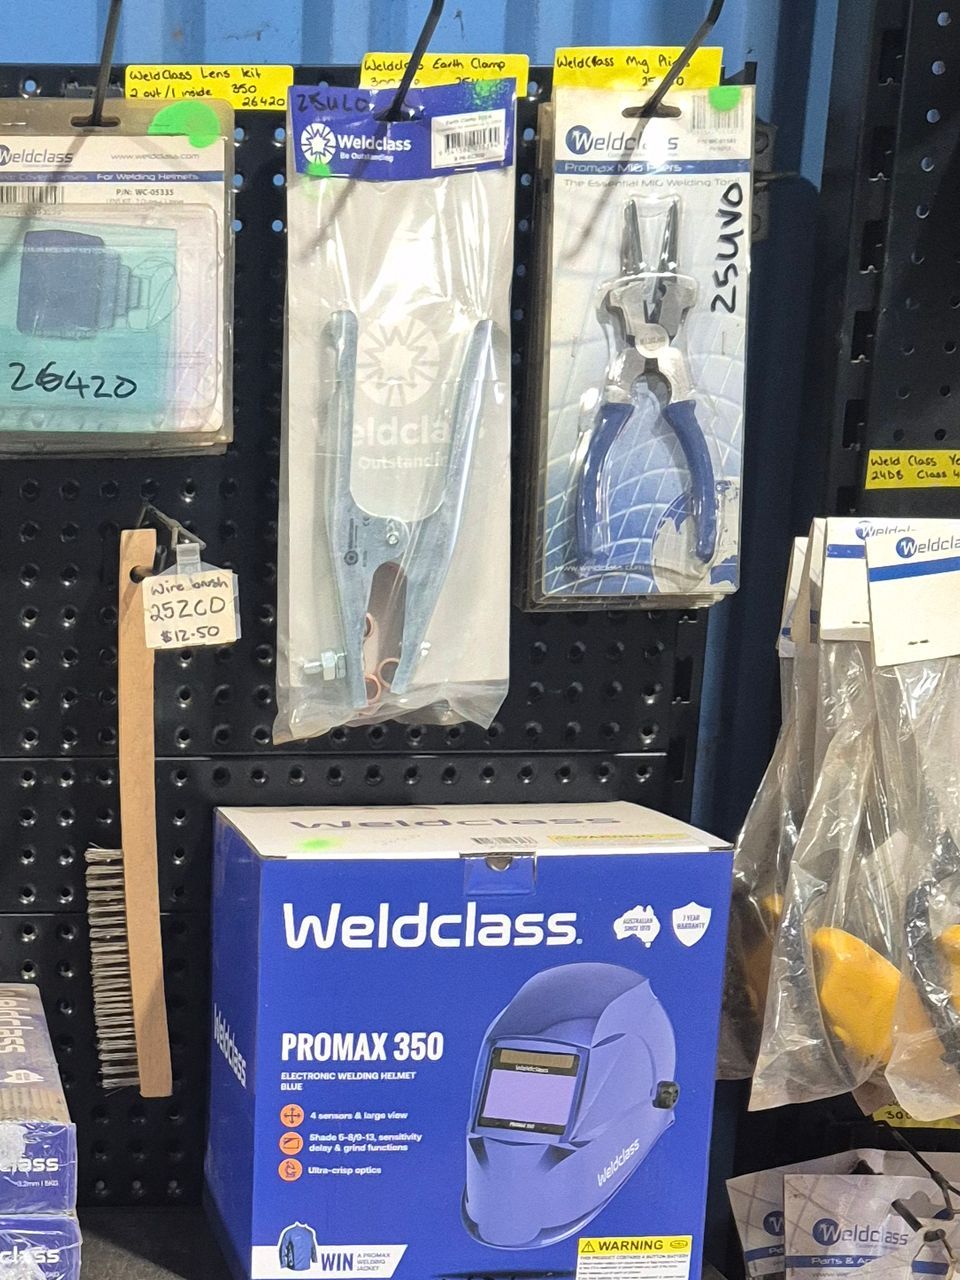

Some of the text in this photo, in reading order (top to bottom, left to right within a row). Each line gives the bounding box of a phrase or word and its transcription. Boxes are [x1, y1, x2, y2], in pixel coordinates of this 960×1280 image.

[201, 67, 230, 79] Lens
[337, 134, 411, 151] Weldclass
[281, 1031, 445, 1061] PROMAX 350
[280, 1071, 416, 1081] ELECTRONIC WELDING HELMET
[280, 1083, 303, 1091] BLUE
[599, 1240, 664, 1251] WARNING
